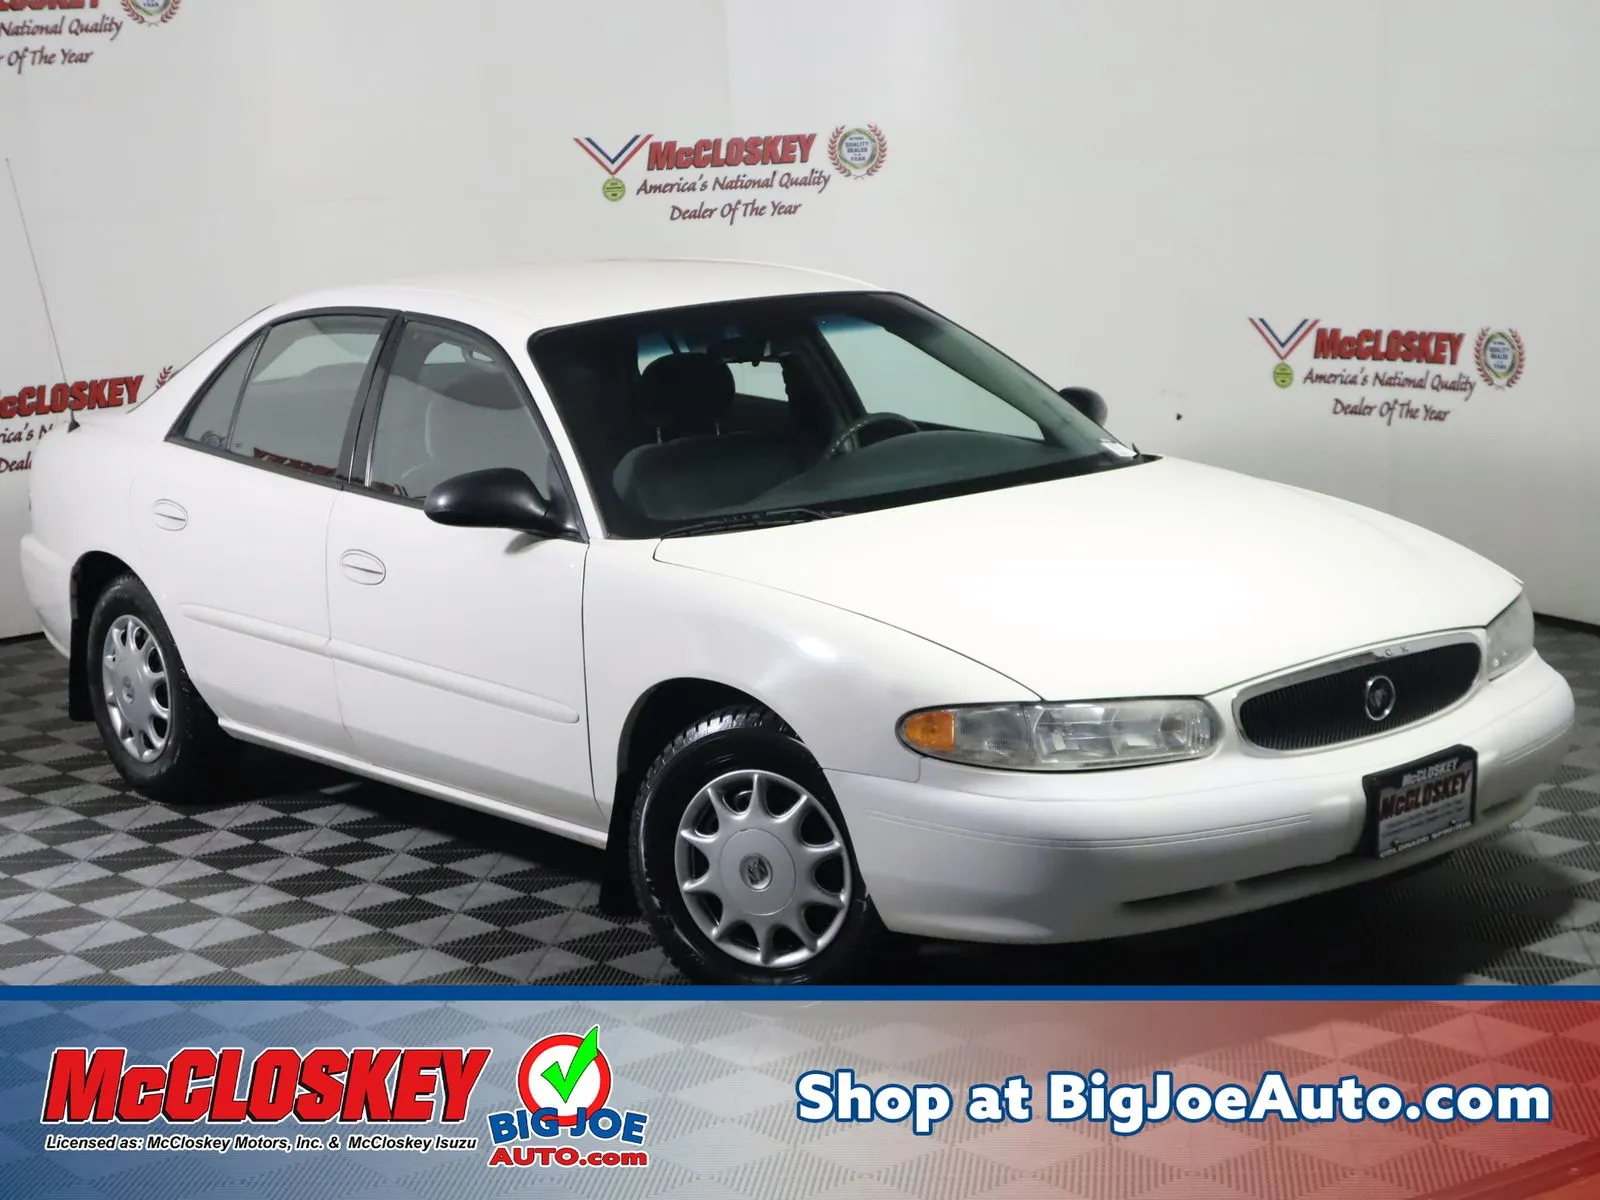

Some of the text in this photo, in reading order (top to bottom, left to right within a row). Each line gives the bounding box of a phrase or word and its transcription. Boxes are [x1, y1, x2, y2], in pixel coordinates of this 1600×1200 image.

[0, 13, 123, 41] National Quality
[7, 46, 29, 75] Of
[29, 45, 56, 65] The
[61, 48, 94, 65] Year
[647, 133, 817, 171] McCLOSKEY
[636, 174, 708, 196] America's
[712, 171, 776, 192] National
[779, 168, 831, 195] Quality
[670, 199, 802, 225] Dealer Of The Year
[1314, 327, 1466, 365] McCLOSKEY
[0, 375, 144, 419] cCLOSKEY
[1303, 367, 1368, 386] America's
[1372, 369, 1428, 390] National
[1431, 370, 1476, 401] Quality
[1332, 397, 1450, 425] Dealer Of The Year
[1402, 757, 1459, 788] McCLOSKEY
[1381, 769, 1472, 819] McCLOSKEY
